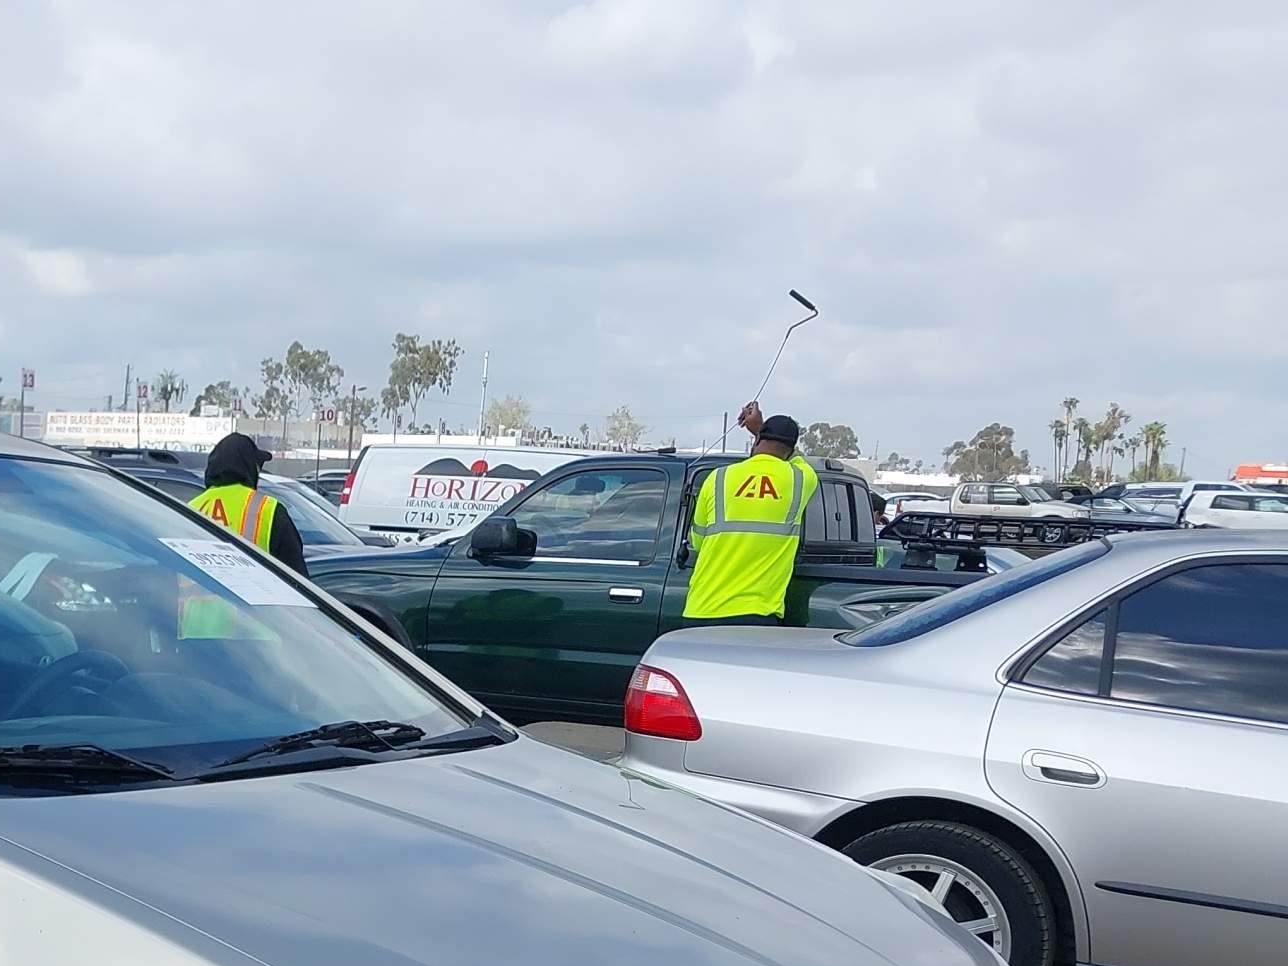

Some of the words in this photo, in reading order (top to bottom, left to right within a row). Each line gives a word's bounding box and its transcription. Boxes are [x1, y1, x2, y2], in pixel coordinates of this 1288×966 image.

[137, 385, 148, 398] 12
[48, 415, 67, 425] AUTO
[70, 415, 92, 425] GLASS
[96, 415, 114, 425] BODY
[118, 416, 140, 425] PART
[144, 416, 185, 426] RADIATORS
[320, 410, 334, 421] 10
[406, 500, 437, 510] HEATING
[439, 502, 445, 510] &
[447, 502, 460, 510] AIR
[462, 503, 501, 513] CONDITIO
[405, 511, 440, 524] (714)
[445, 513, 478, 527] 577
